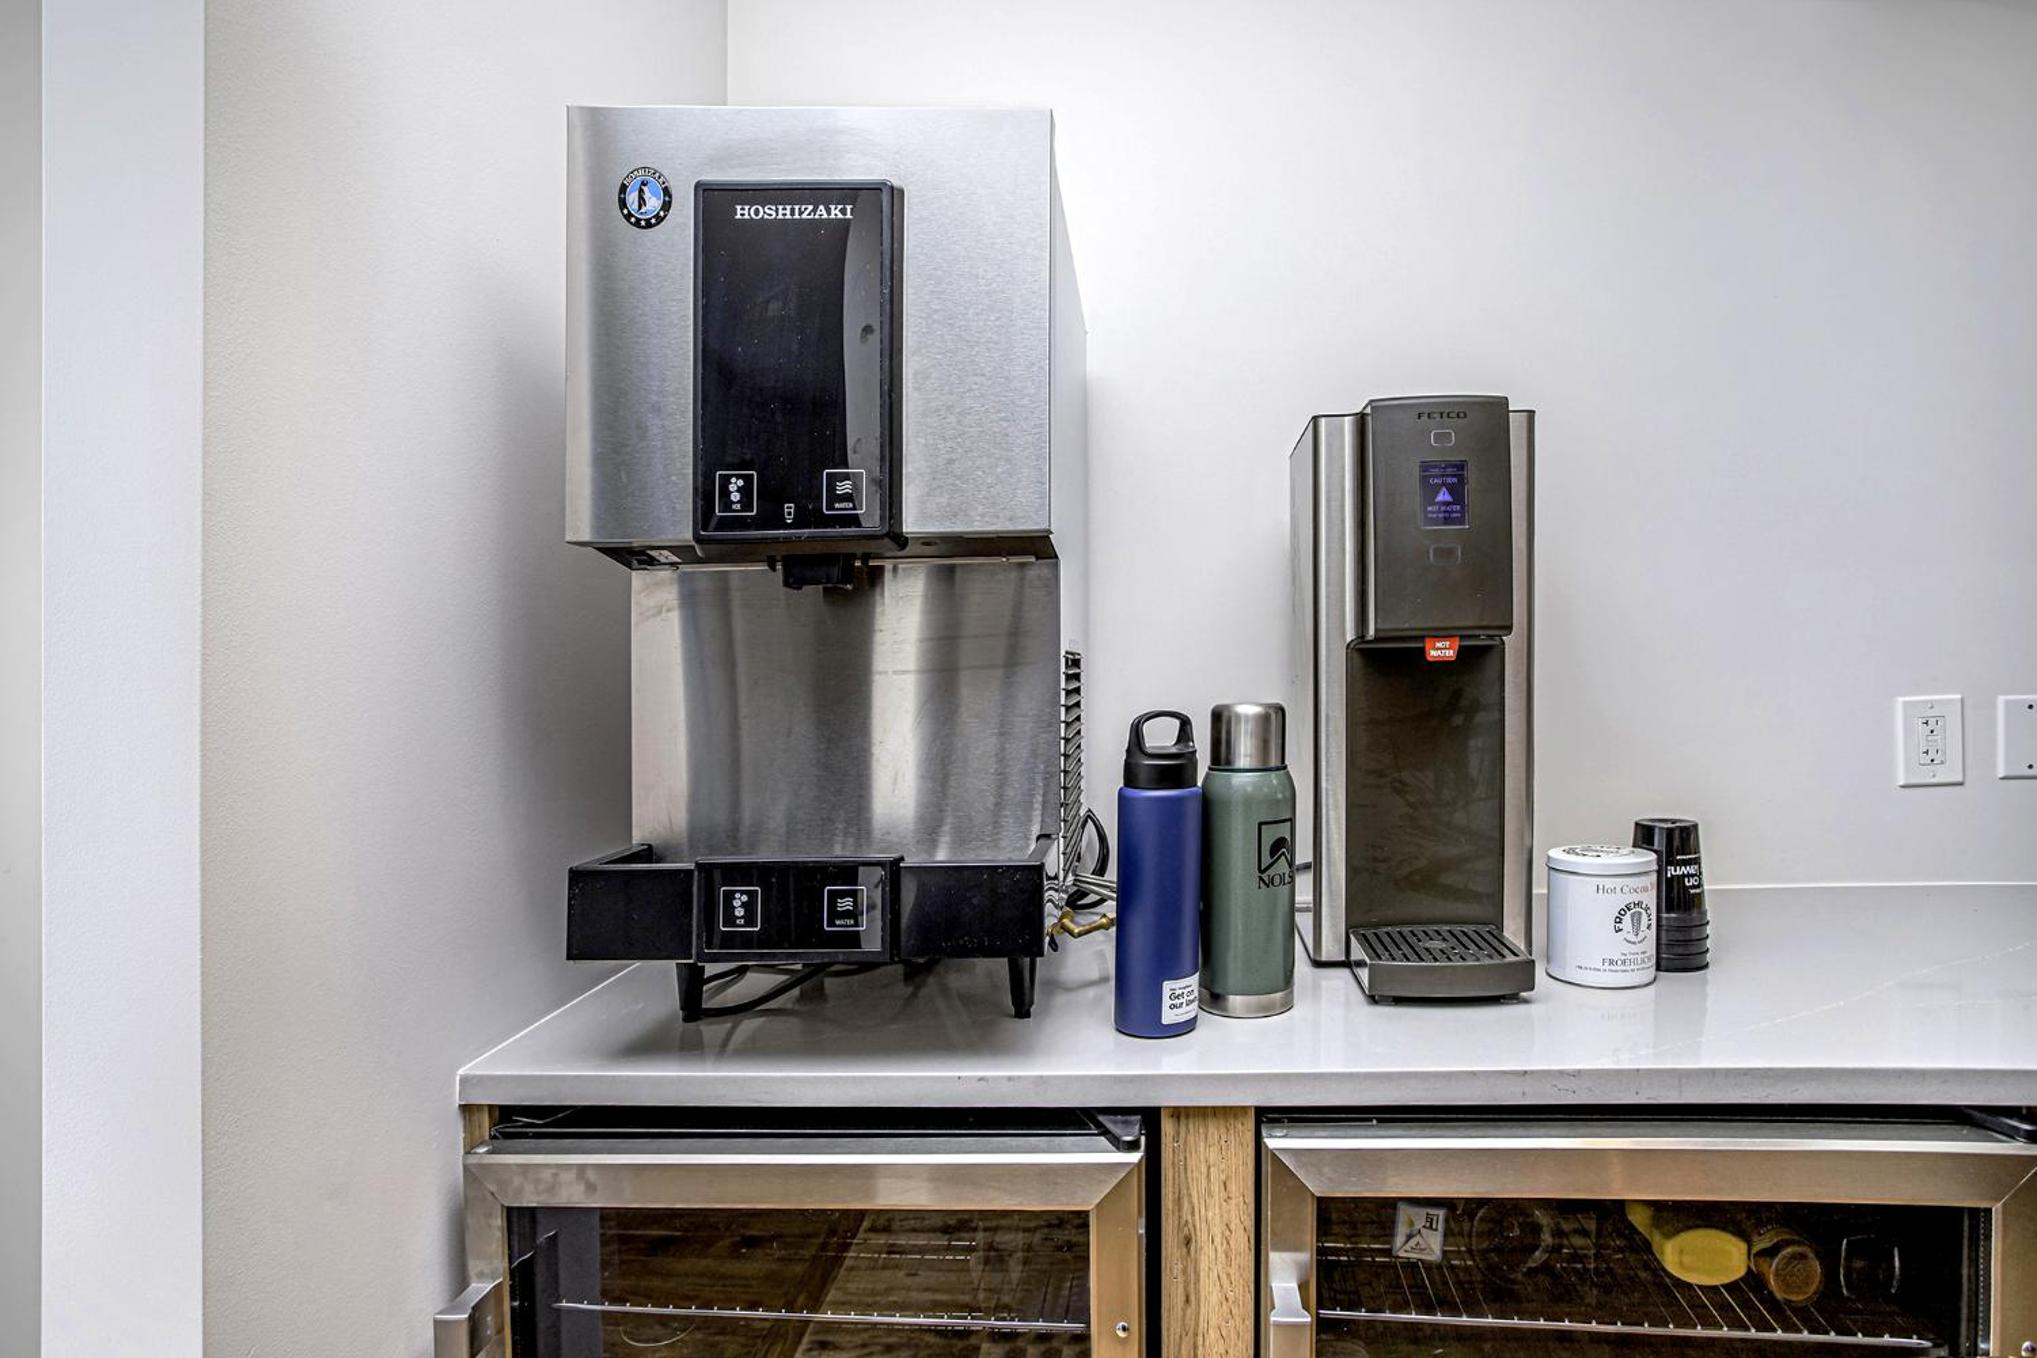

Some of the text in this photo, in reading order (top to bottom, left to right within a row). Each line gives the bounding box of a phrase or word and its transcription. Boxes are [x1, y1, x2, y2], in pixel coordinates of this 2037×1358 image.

[734, 204, 853, 220] HOSHIZAKI
[1417, 410, 1467, 420] FETCO
[1257, 870, 1294, 889] NOLS
[1596, 884, 1617, 895] Hot
[1620, 884, 1649, 895] Cocoa
[1168, 991, 1185, 1001] Get
